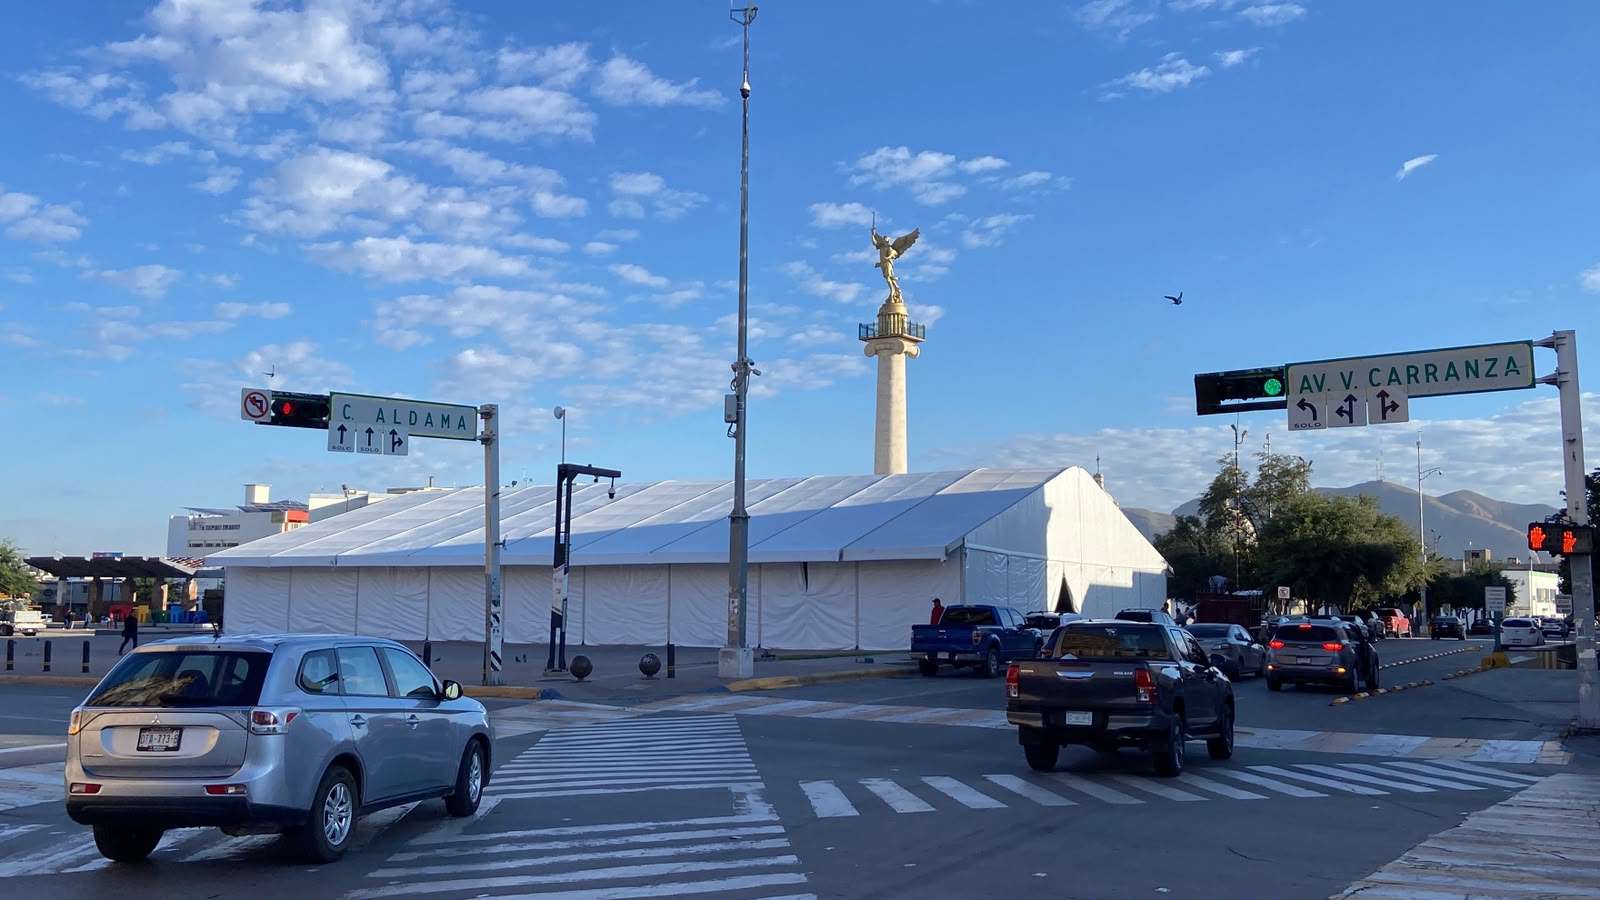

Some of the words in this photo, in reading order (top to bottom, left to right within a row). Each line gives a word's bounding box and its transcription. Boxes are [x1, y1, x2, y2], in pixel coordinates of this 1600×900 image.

[1300, 373, 1331, 394] AV.
[1340, 371, 1358, 390] V.
[1368, 355, 1521, 387] CARRANZA
[342, 403, 355, 421] C.
[376, 407, 467, 430] ALDAMA
